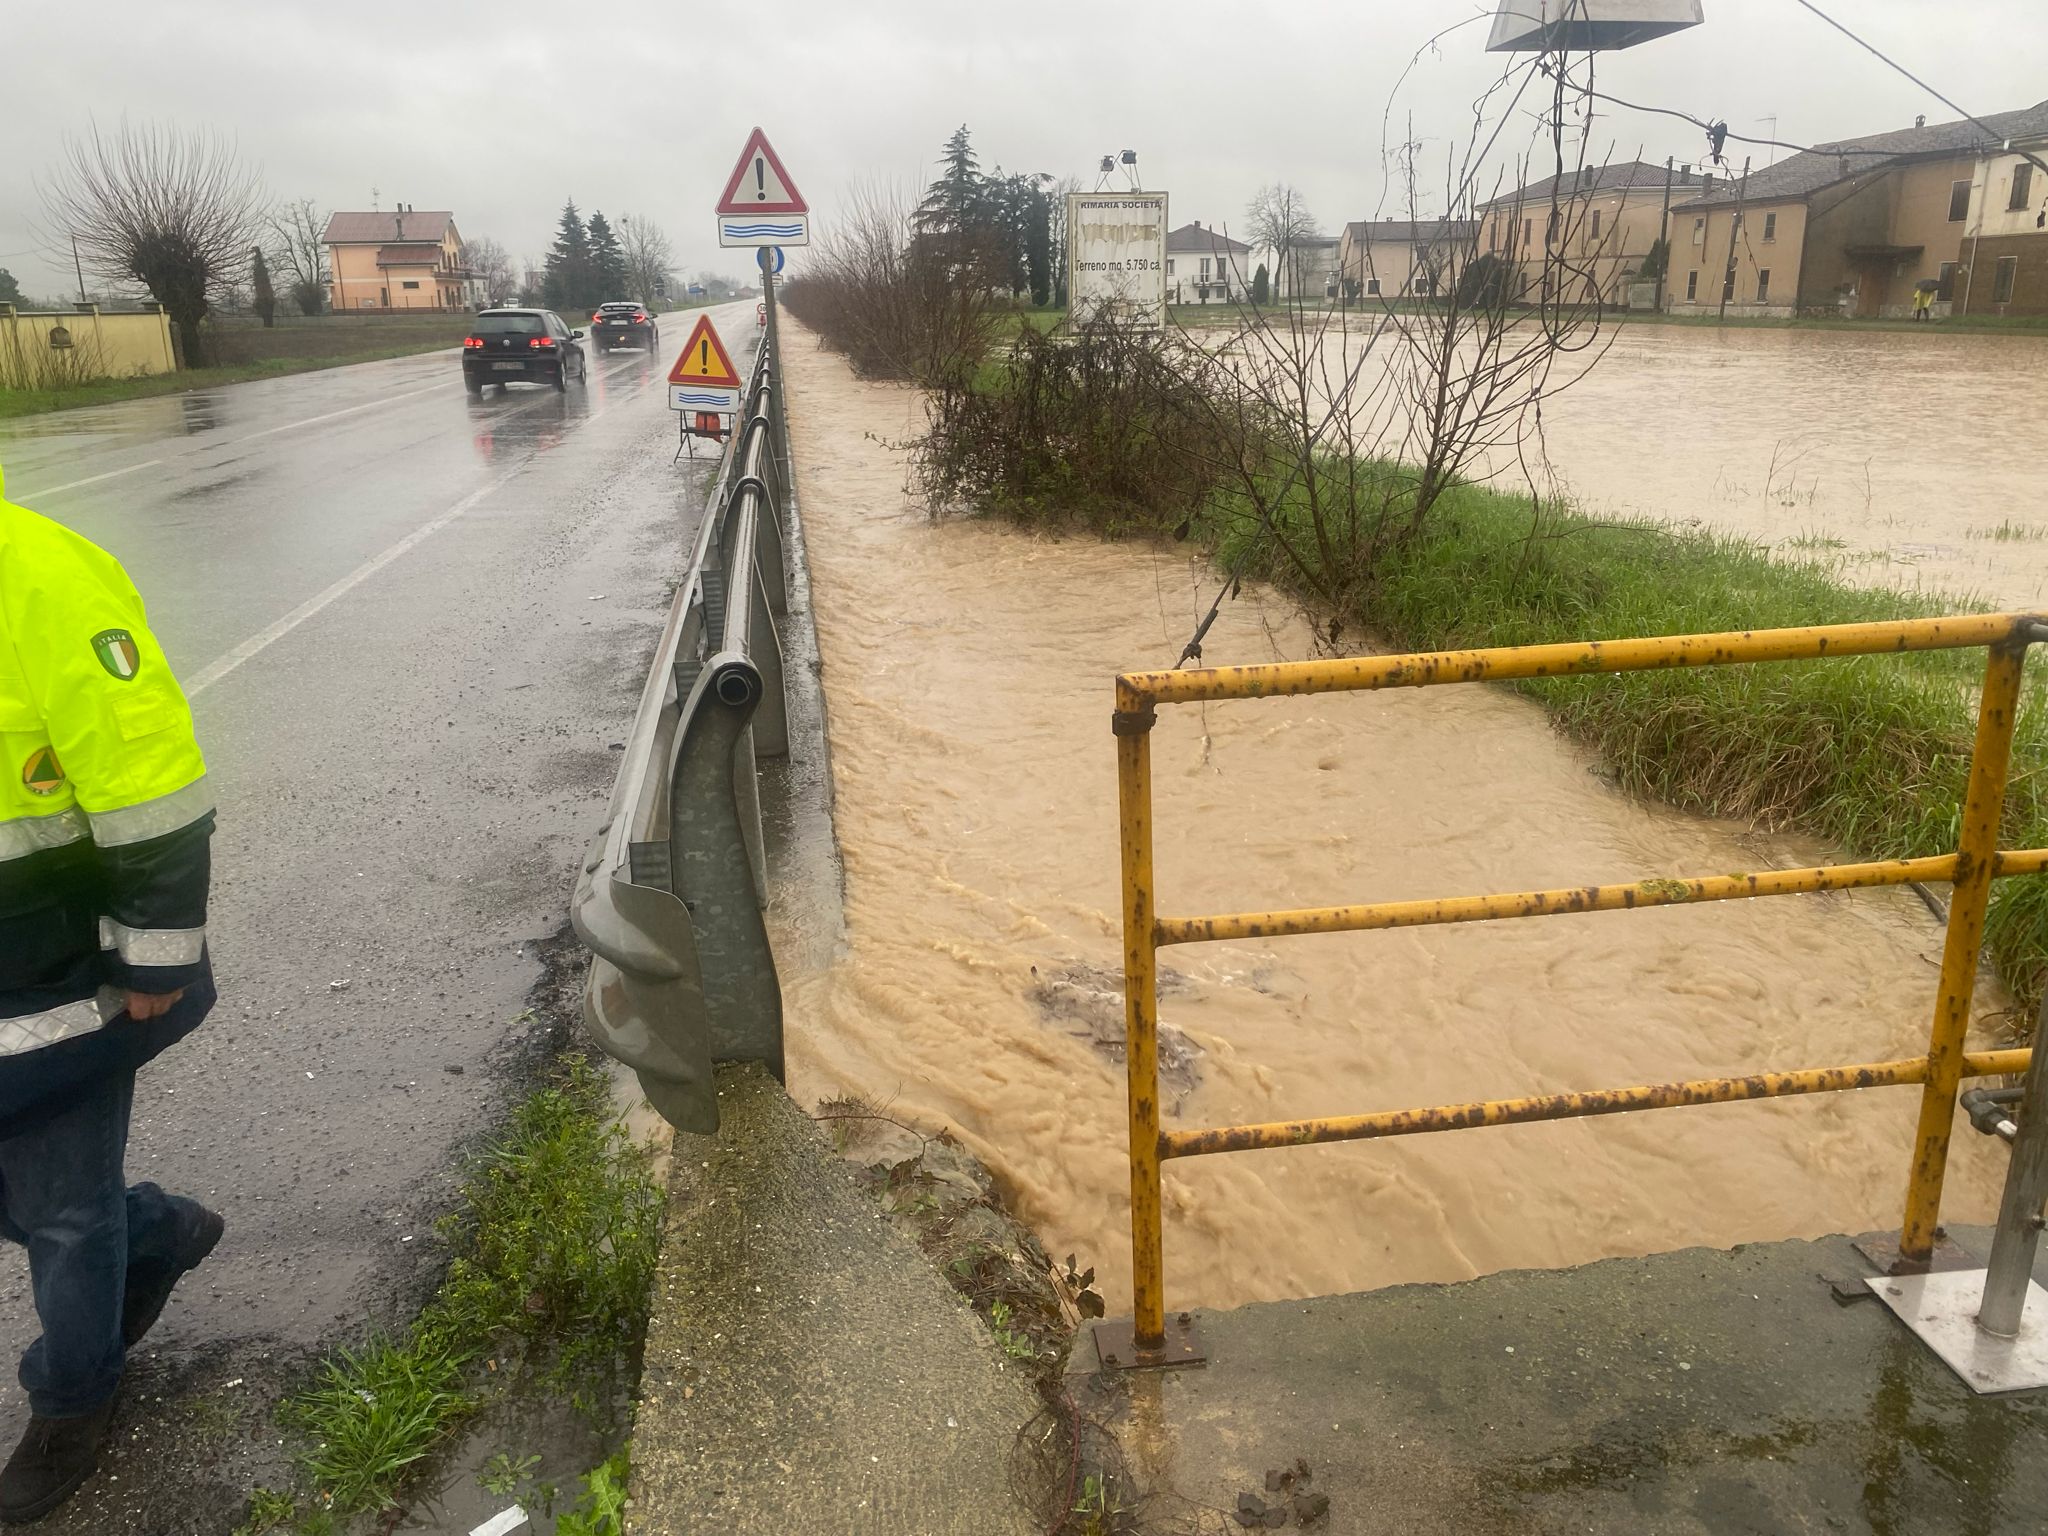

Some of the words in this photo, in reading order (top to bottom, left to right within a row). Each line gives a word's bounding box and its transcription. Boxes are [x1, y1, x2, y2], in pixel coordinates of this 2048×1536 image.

[1075, 259, 1107, 271] Terreno
[1126, 258, 1148, 271] 5.750
[98, 634, 126, 646] ITALIA
